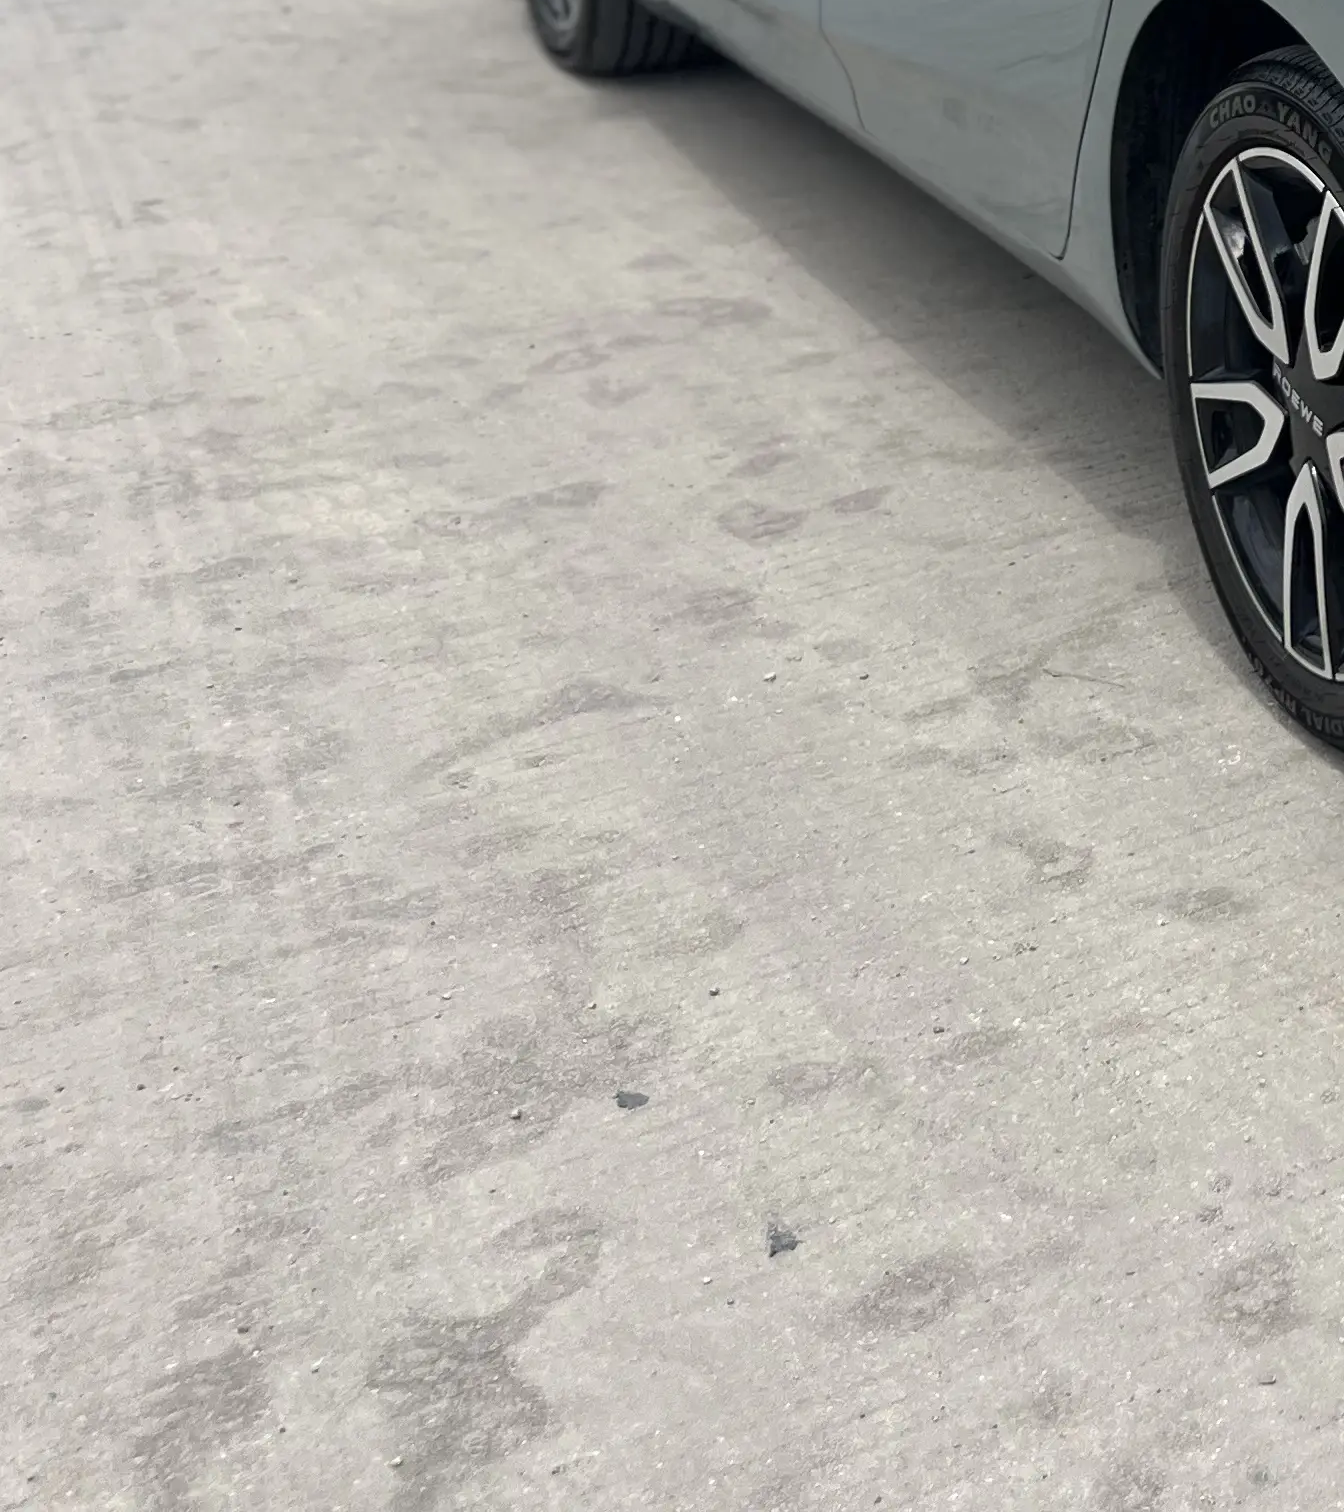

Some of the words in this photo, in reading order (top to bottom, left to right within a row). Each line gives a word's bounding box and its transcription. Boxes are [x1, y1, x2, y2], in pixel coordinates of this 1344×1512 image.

[1208, 93, 1257, 130] CHAO
[1276, 100, 1334, 166] YANG
[1272, 361, 1324, 438] ROEWE
